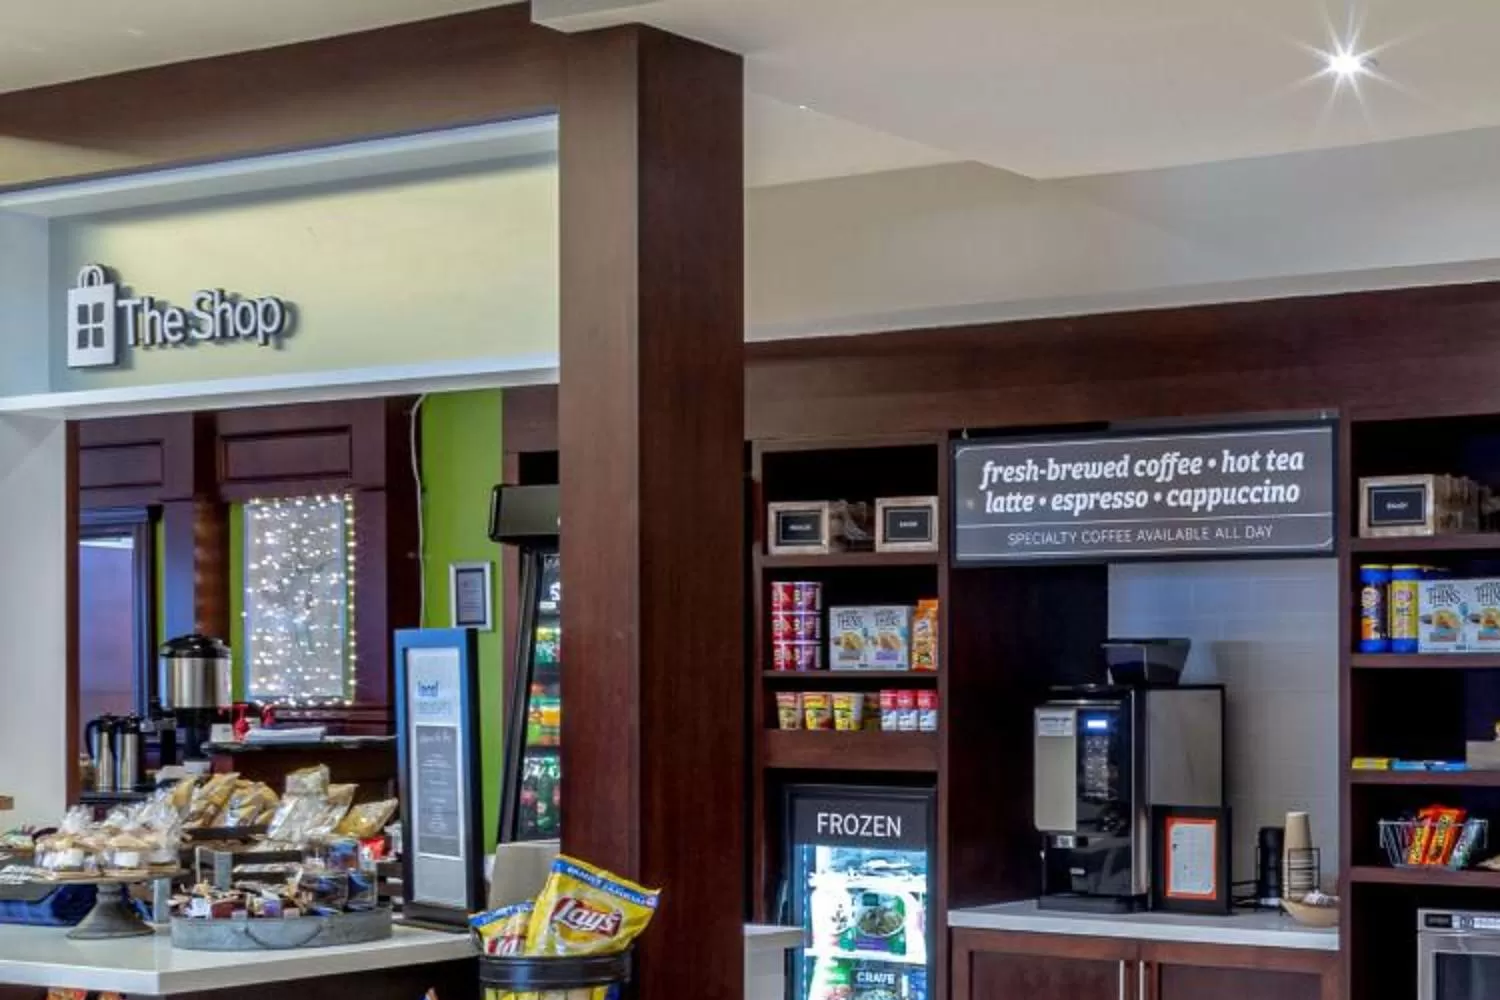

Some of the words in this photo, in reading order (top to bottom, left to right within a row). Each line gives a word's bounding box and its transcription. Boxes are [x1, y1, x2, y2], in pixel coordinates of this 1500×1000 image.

[117, 297, 186, 346] The
[190, 288, 284, 346] Shop
[979, 455, 1131, 490] fresh-brewed
[1133, 452, 1203, 483] coffee
[1221, 449, 1261, 473] hot
[1266, 450, 1305, 471] tea
[985, 490, 1034, 514] latte
[1051, 487, 1148, 516] espresso
[1167, 479, 1300, 512] cappuccino
[1007, 530, 1077, 546] SPECIALTY
[1081, 529, 1132, 544] COFFEE
[1137, 526, 1210, 543] AVAILABLE
[1215, 525, 1241, 540] ALL
[1245, 524, 1274, 539] DAY
[817, 812, 902, 837] FROZEN
[553, 899, 621, 934] Lay's
